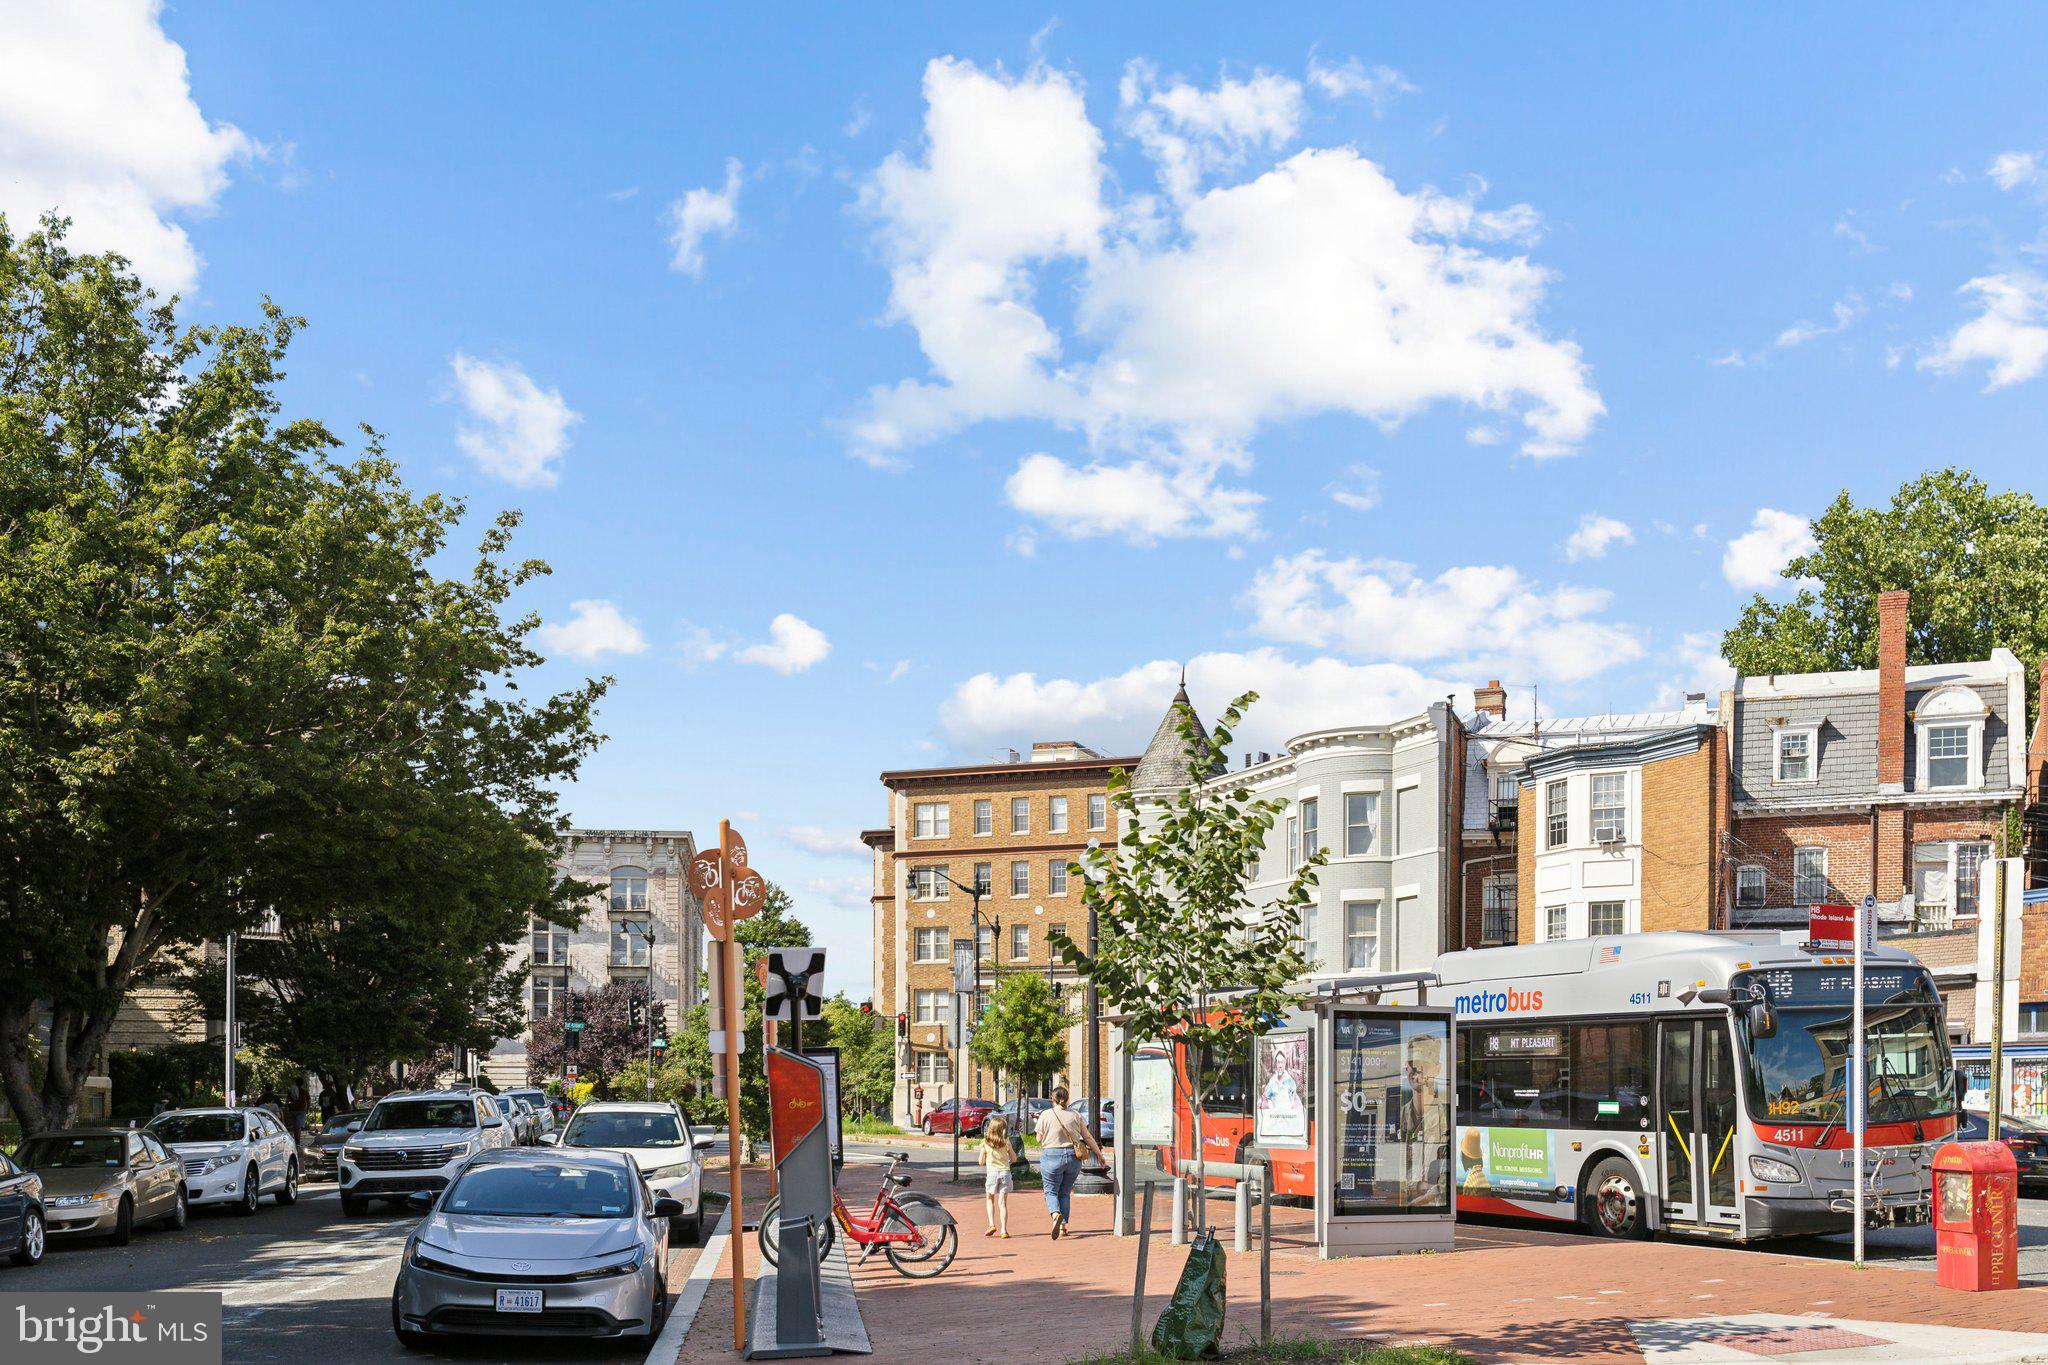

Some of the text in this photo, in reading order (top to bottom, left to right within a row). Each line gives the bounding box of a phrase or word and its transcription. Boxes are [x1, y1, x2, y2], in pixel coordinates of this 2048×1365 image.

[1811, 905, 1821, 914] H8
[1811, 913, 1827, 921] Rhode
[1820, 977, 1837, 990] MT
[1841, 976, 1902, 990] PLASANT
[1456, 986, 1651, 1014] metrobus 4511
[1341, 1026, 1351, 1035] VA
[1489, 1036, 1555, 1051] H8 MT PLEASANT
[1341, 1056, 1381, 1067] $141,000
[1340, 1089, 1366, 1114] $0
[1774, 1129, 1804, 1142] 4511
[1492, 1141, 1544, 1162] NonprofitHR
[500, 1296, 539, 1307] R 41617
